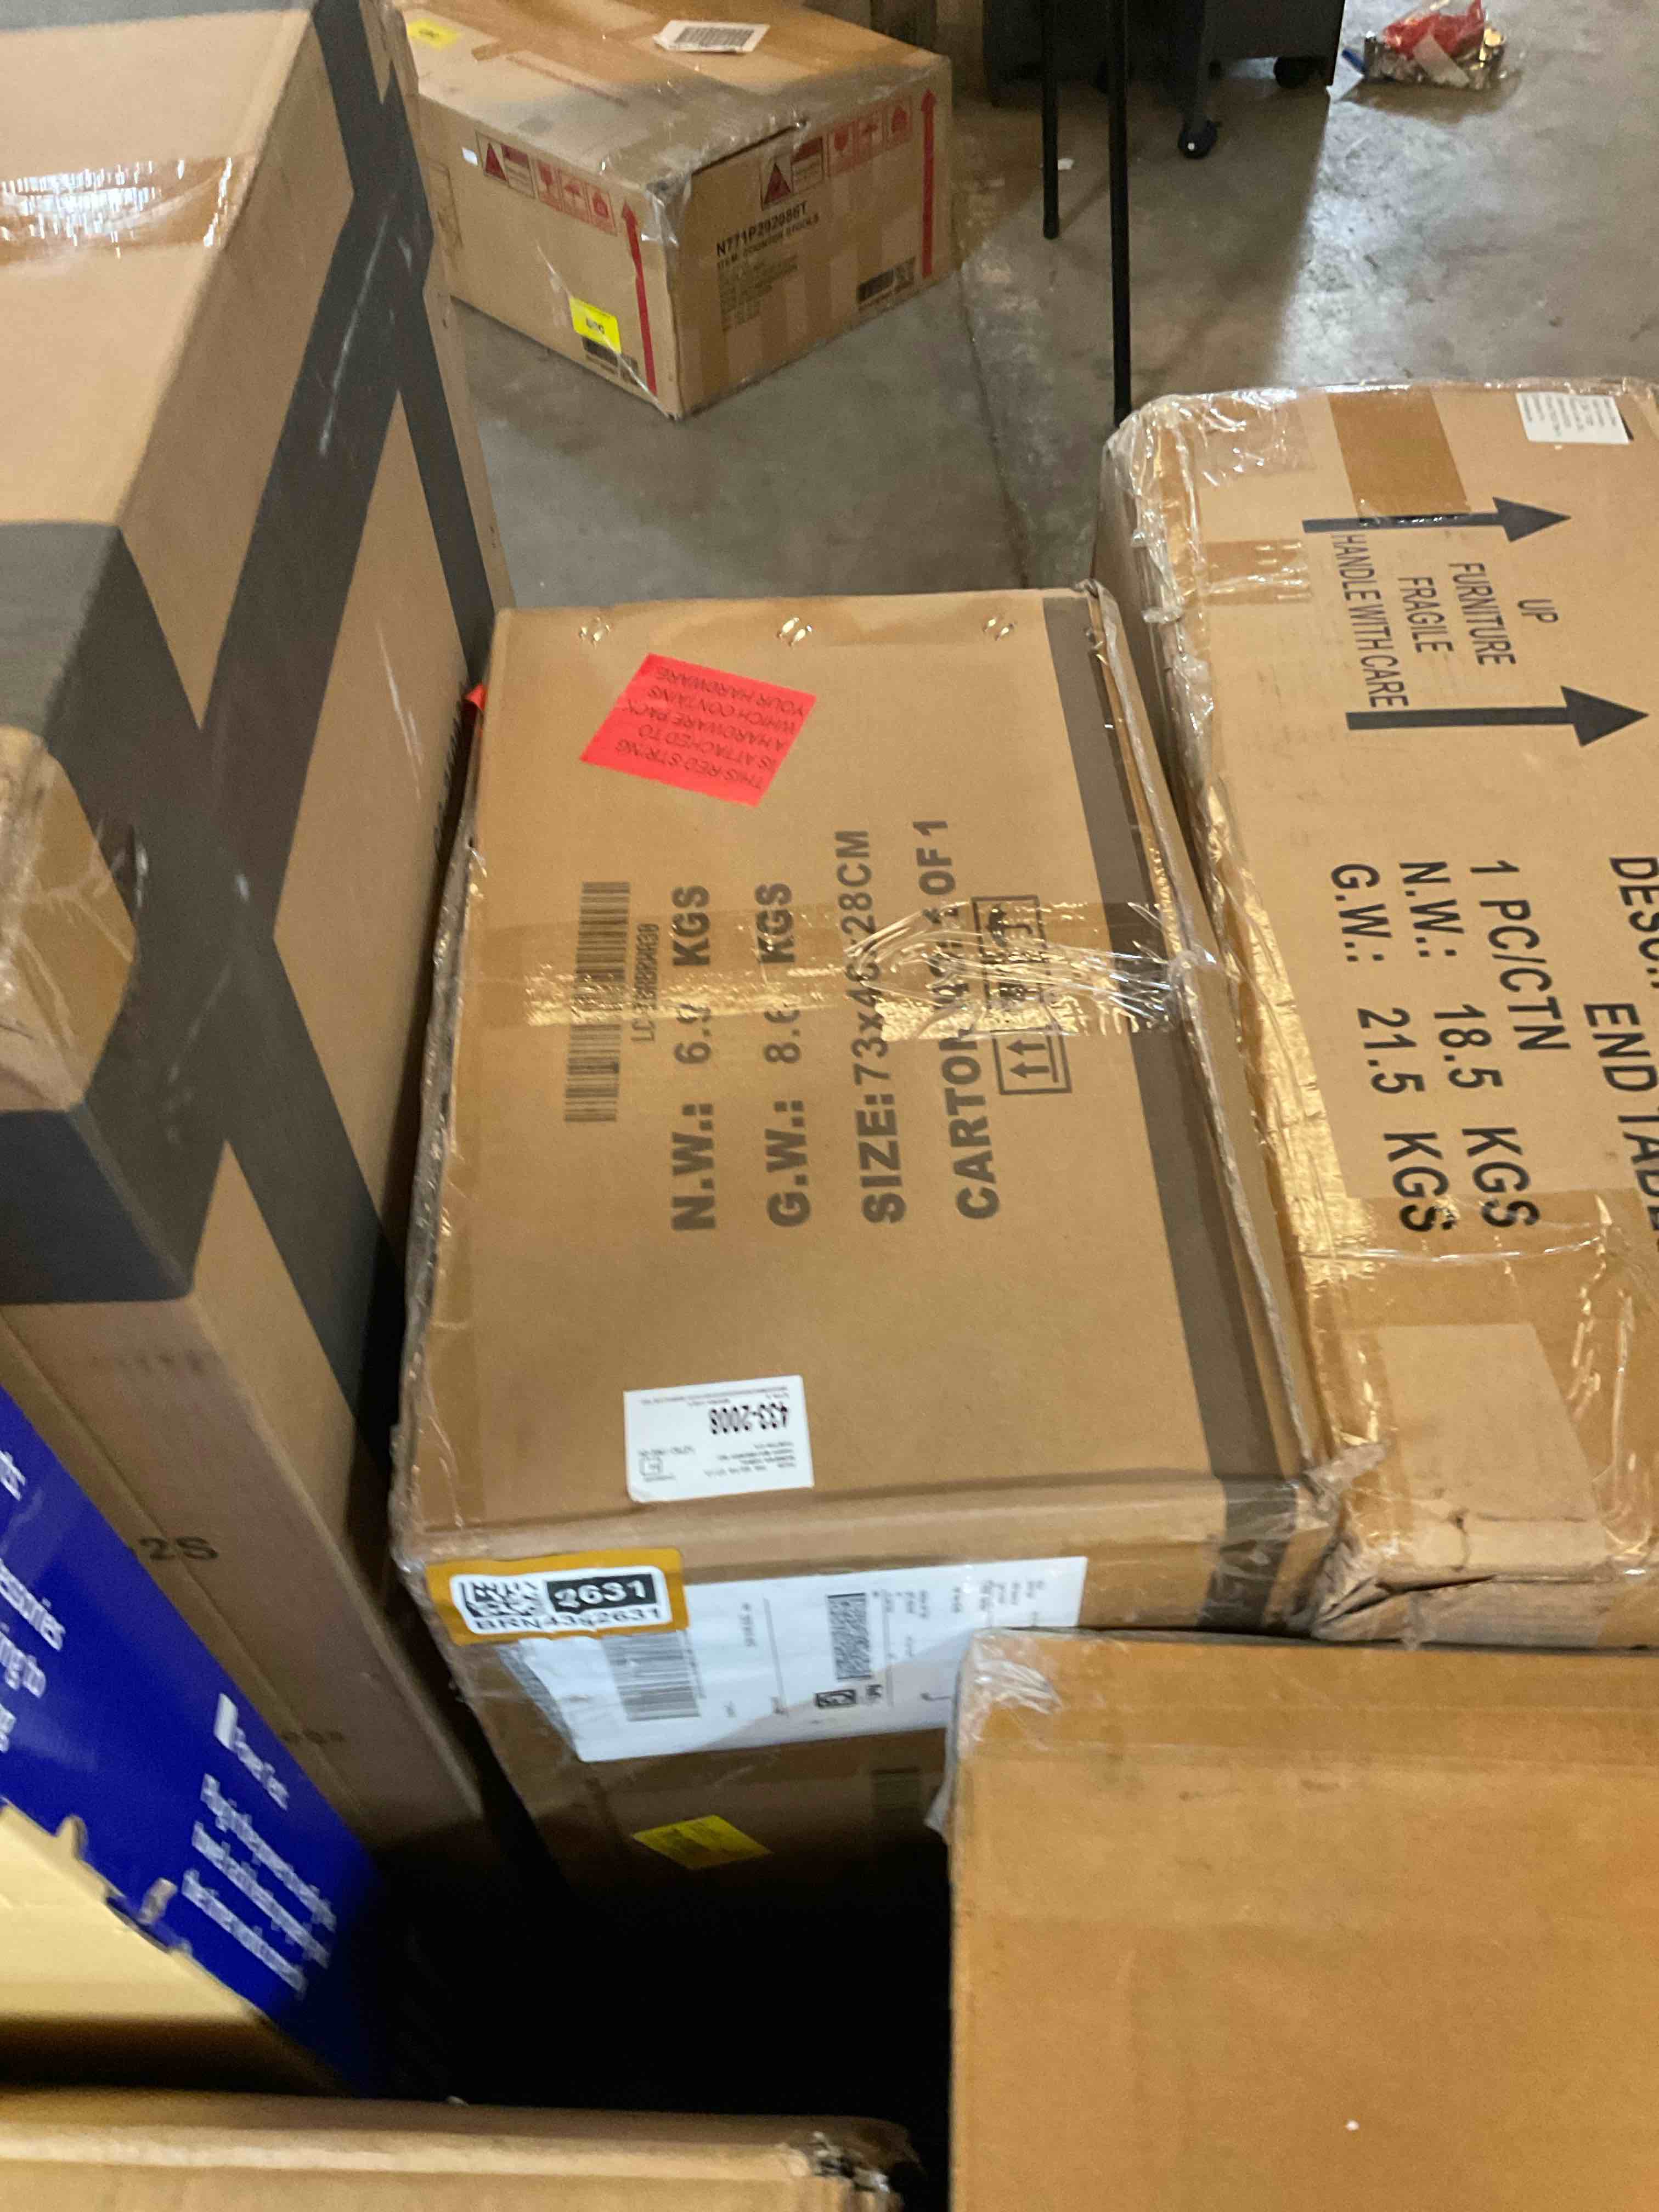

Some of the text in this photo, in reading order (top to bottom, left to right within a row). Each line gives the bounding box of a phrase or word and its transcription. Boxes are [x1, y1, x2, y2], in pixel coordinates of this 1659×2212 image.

[1331, 534, 1409, 708] HANDLE WITH CARE
[1397, 576, 1454, 653] FRAGILE
[1448, 562, 1516, 665] FURNITURE
[1517, 599, 1559, 624] UP
[638, 724, 661, 741] TO
[756, 693, 804, 716] YOUR
[665, 732, 754, 765] ATTACHED
[912, 820, 949, 836] 1
[916, 848, 956, 895] OF
[672, 885, 710, 966] KGS
[755, 883, 795, 964] KGS
[1470, 860, 1572, 1051] 1 PC/CTN
[1331, 863, 1457, 1232] G.W.: 21.5 KGS
[1399, 861, 1540, 1228] N.W.: 18.5 KGS
[1584, 1003, 1659, 1092] END
[671, 1103, 716, 1232] N.W.:
[764, 1099, 812, 1227] G.W.:
[554, 1580, 647, 1609] 2631
